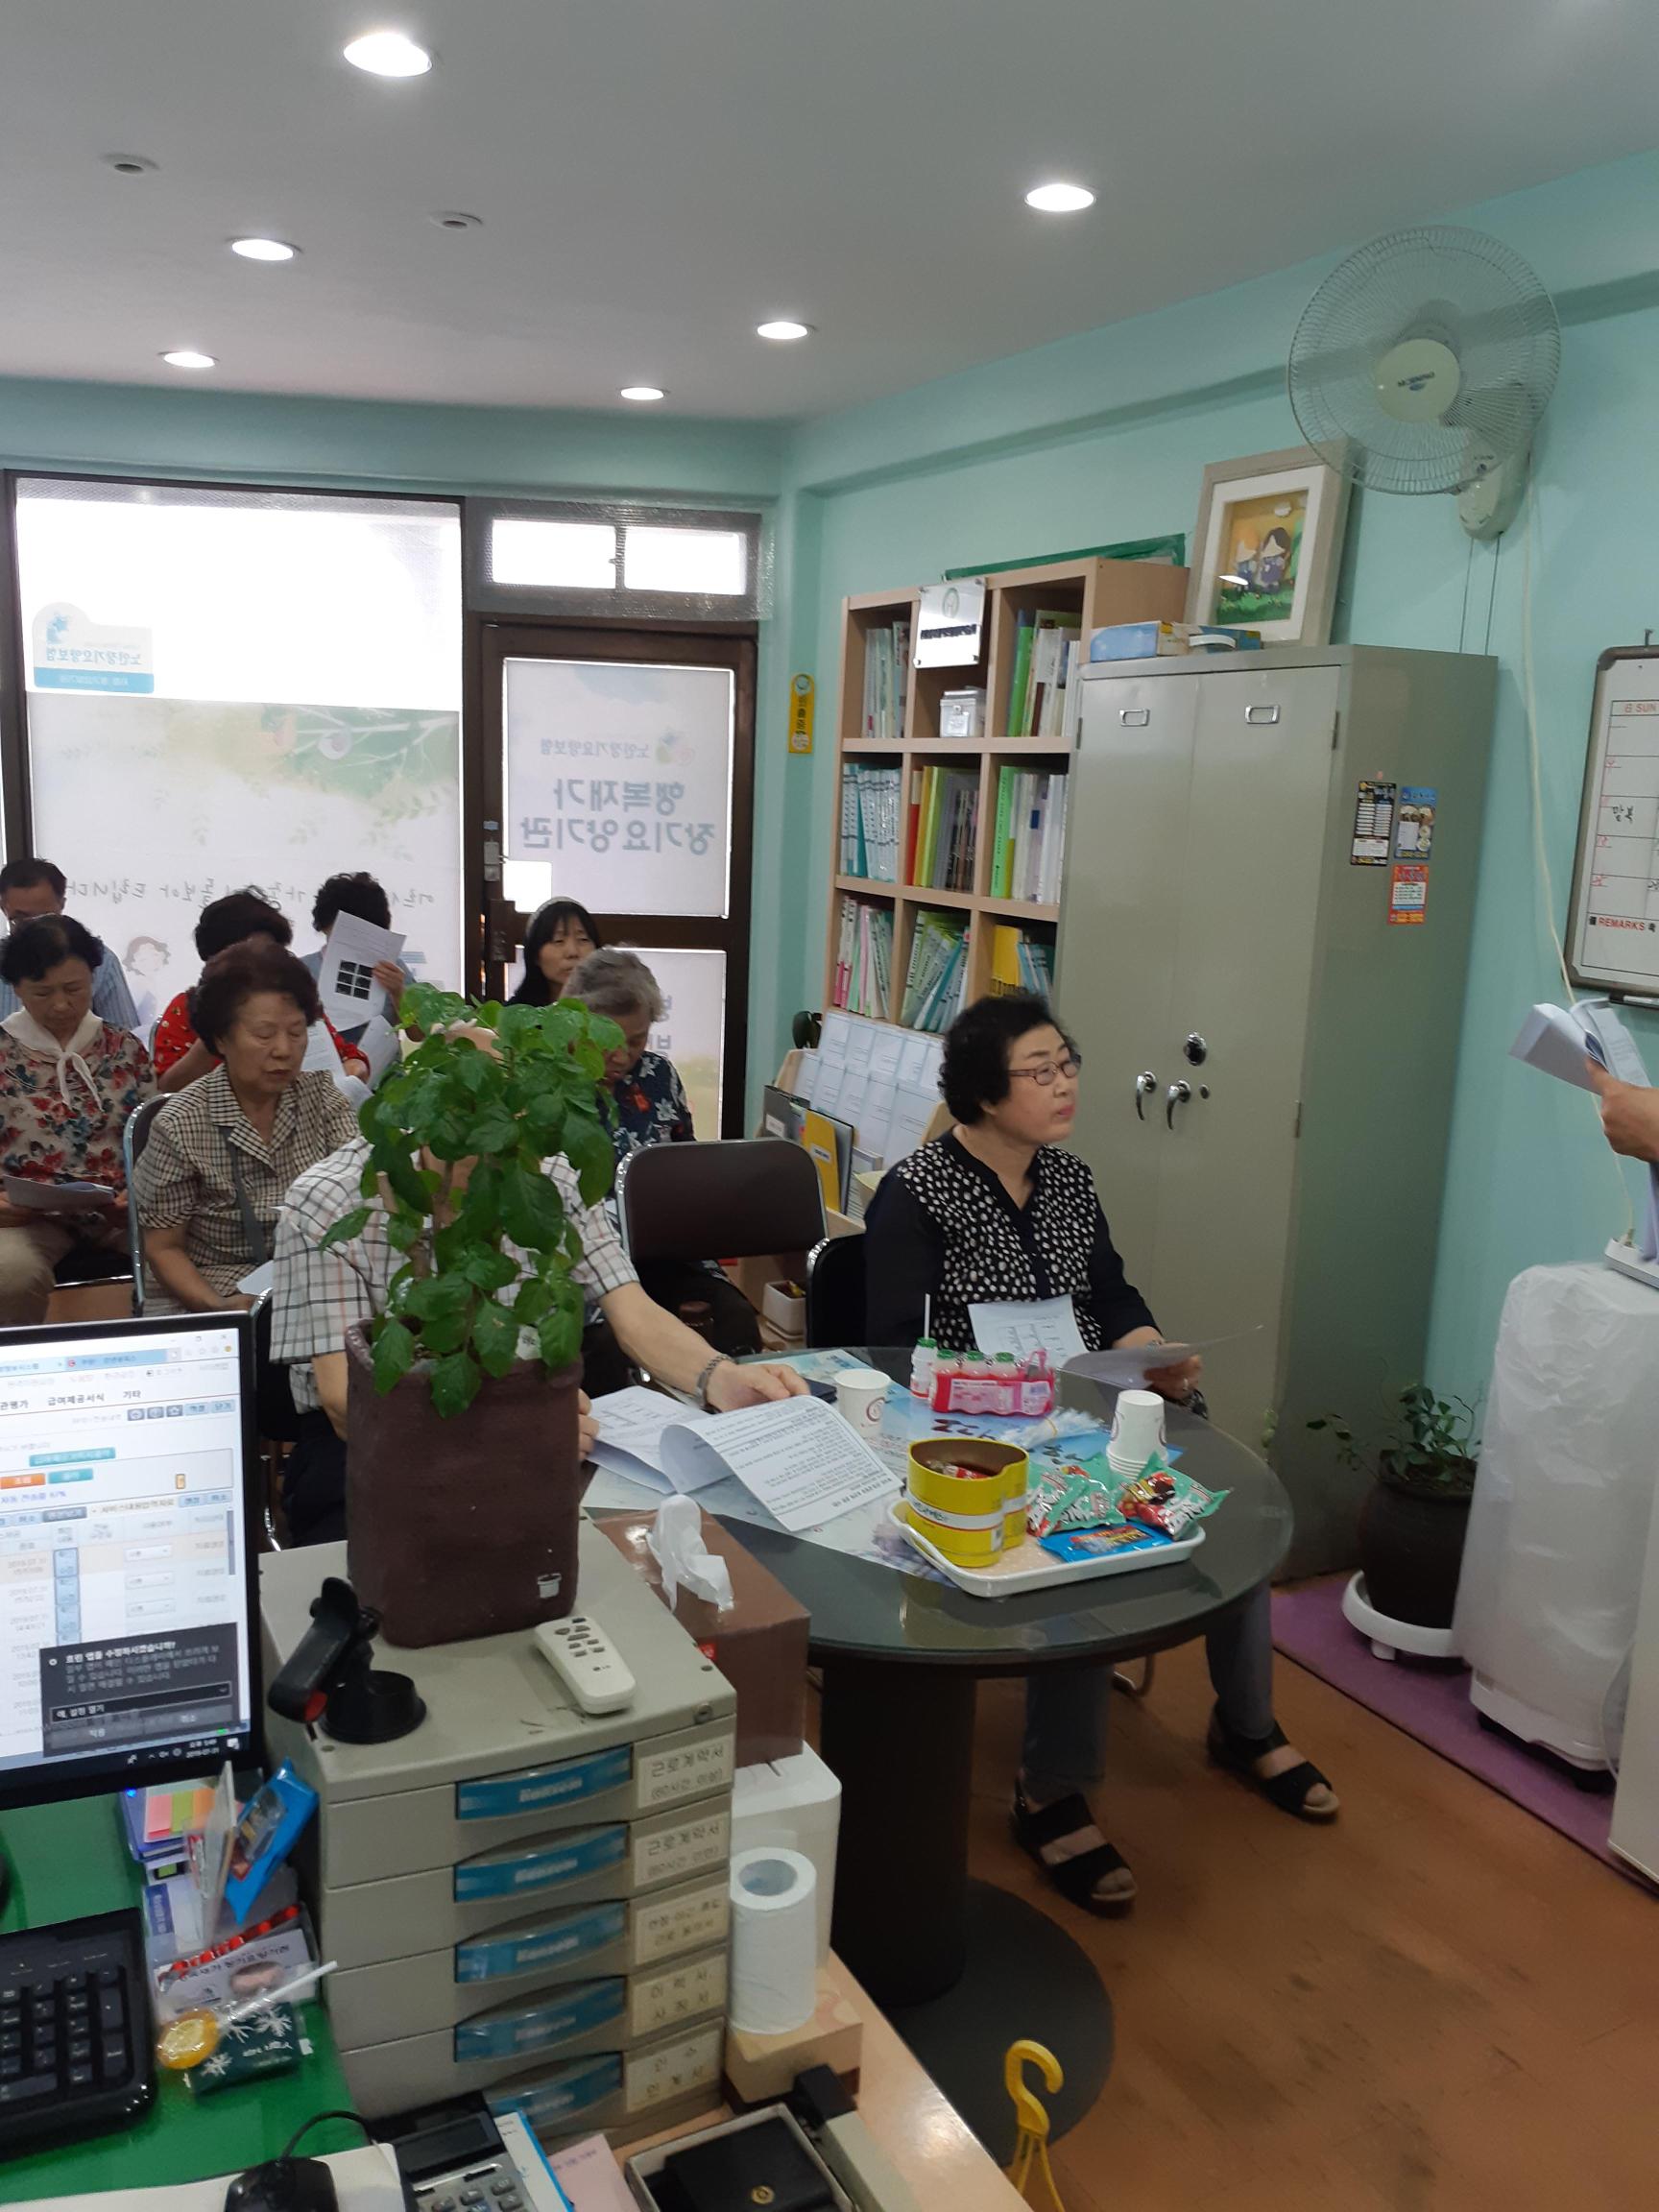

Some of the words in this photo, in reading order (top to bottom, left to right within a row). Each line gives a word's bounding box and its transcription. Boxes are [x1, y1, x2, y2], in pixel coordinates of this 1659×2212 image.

[1635, 703, 1657, 713] SUN
[1599, 916, 1646, 931] REMARKS
[122, 1389, 142, 1400] 기타
[651, 1744, 725, 1778] 근로계약서
